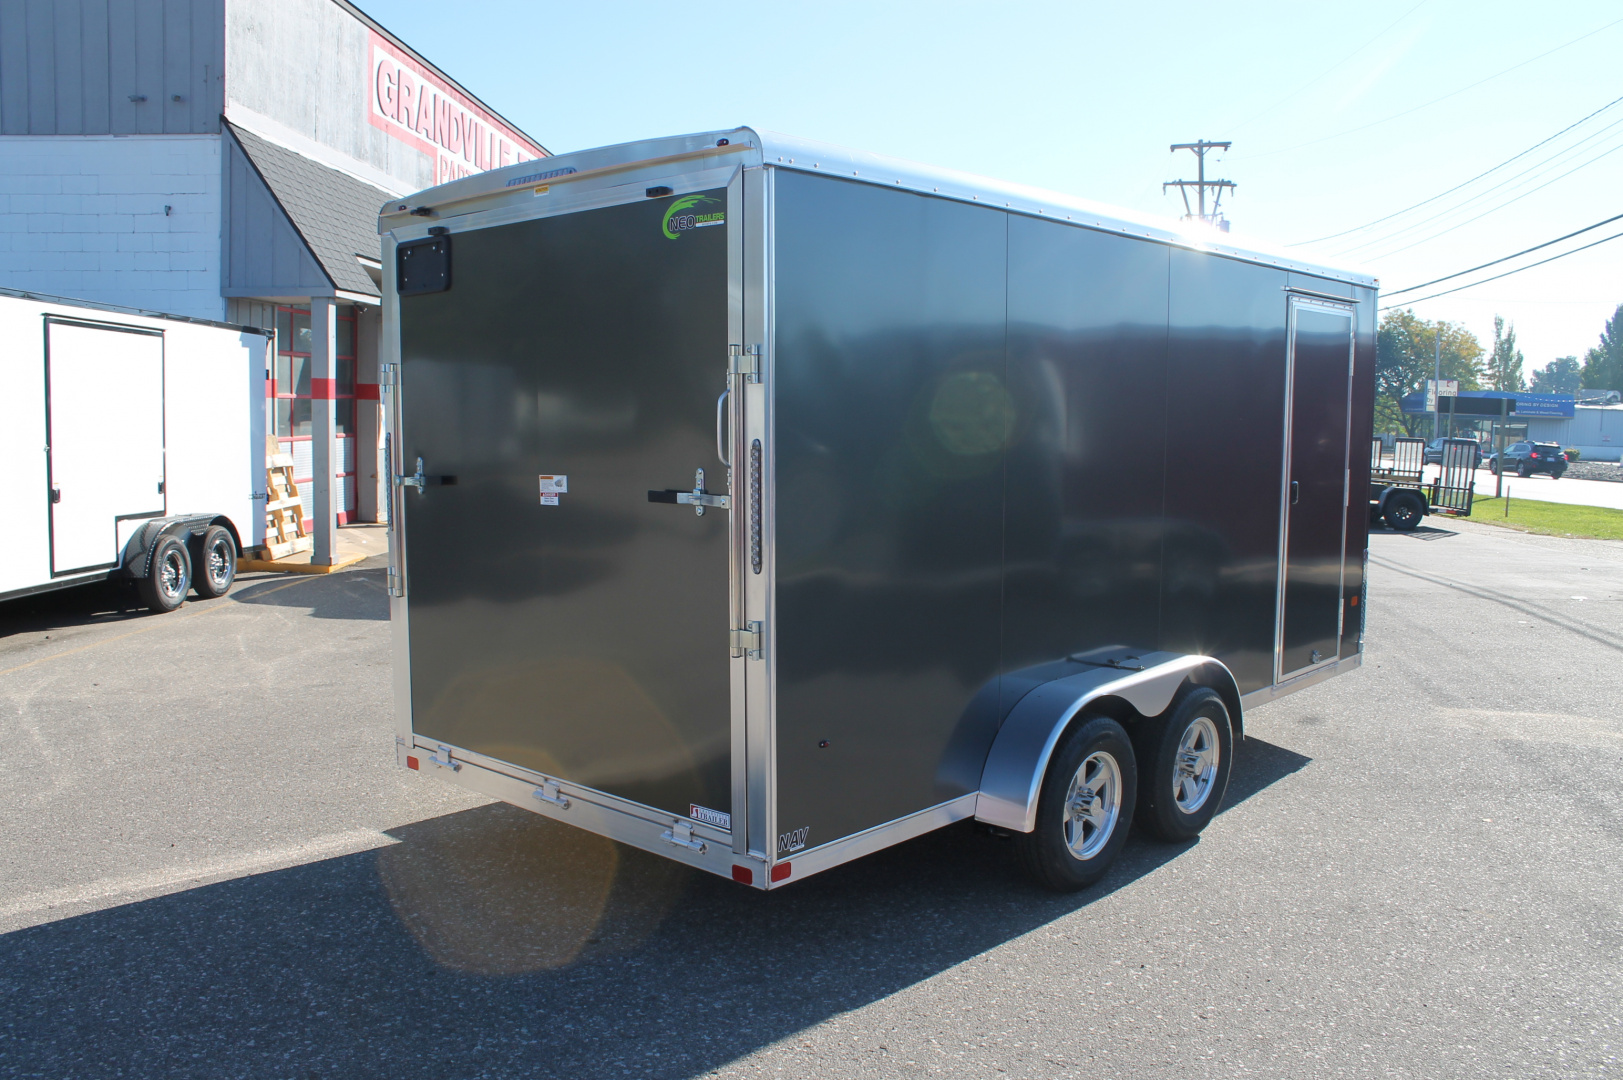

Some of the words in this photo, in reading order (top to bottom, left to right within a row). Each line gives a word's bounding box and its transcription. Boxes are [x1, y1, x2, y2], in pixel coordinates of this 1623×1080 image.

[376, 59, 511, 172] GRANDVILLE
[670, 215, 695, 231] NEO
[696, 212, 724, 222] TRAILERS
[778, 827, 809, 852] NAV
